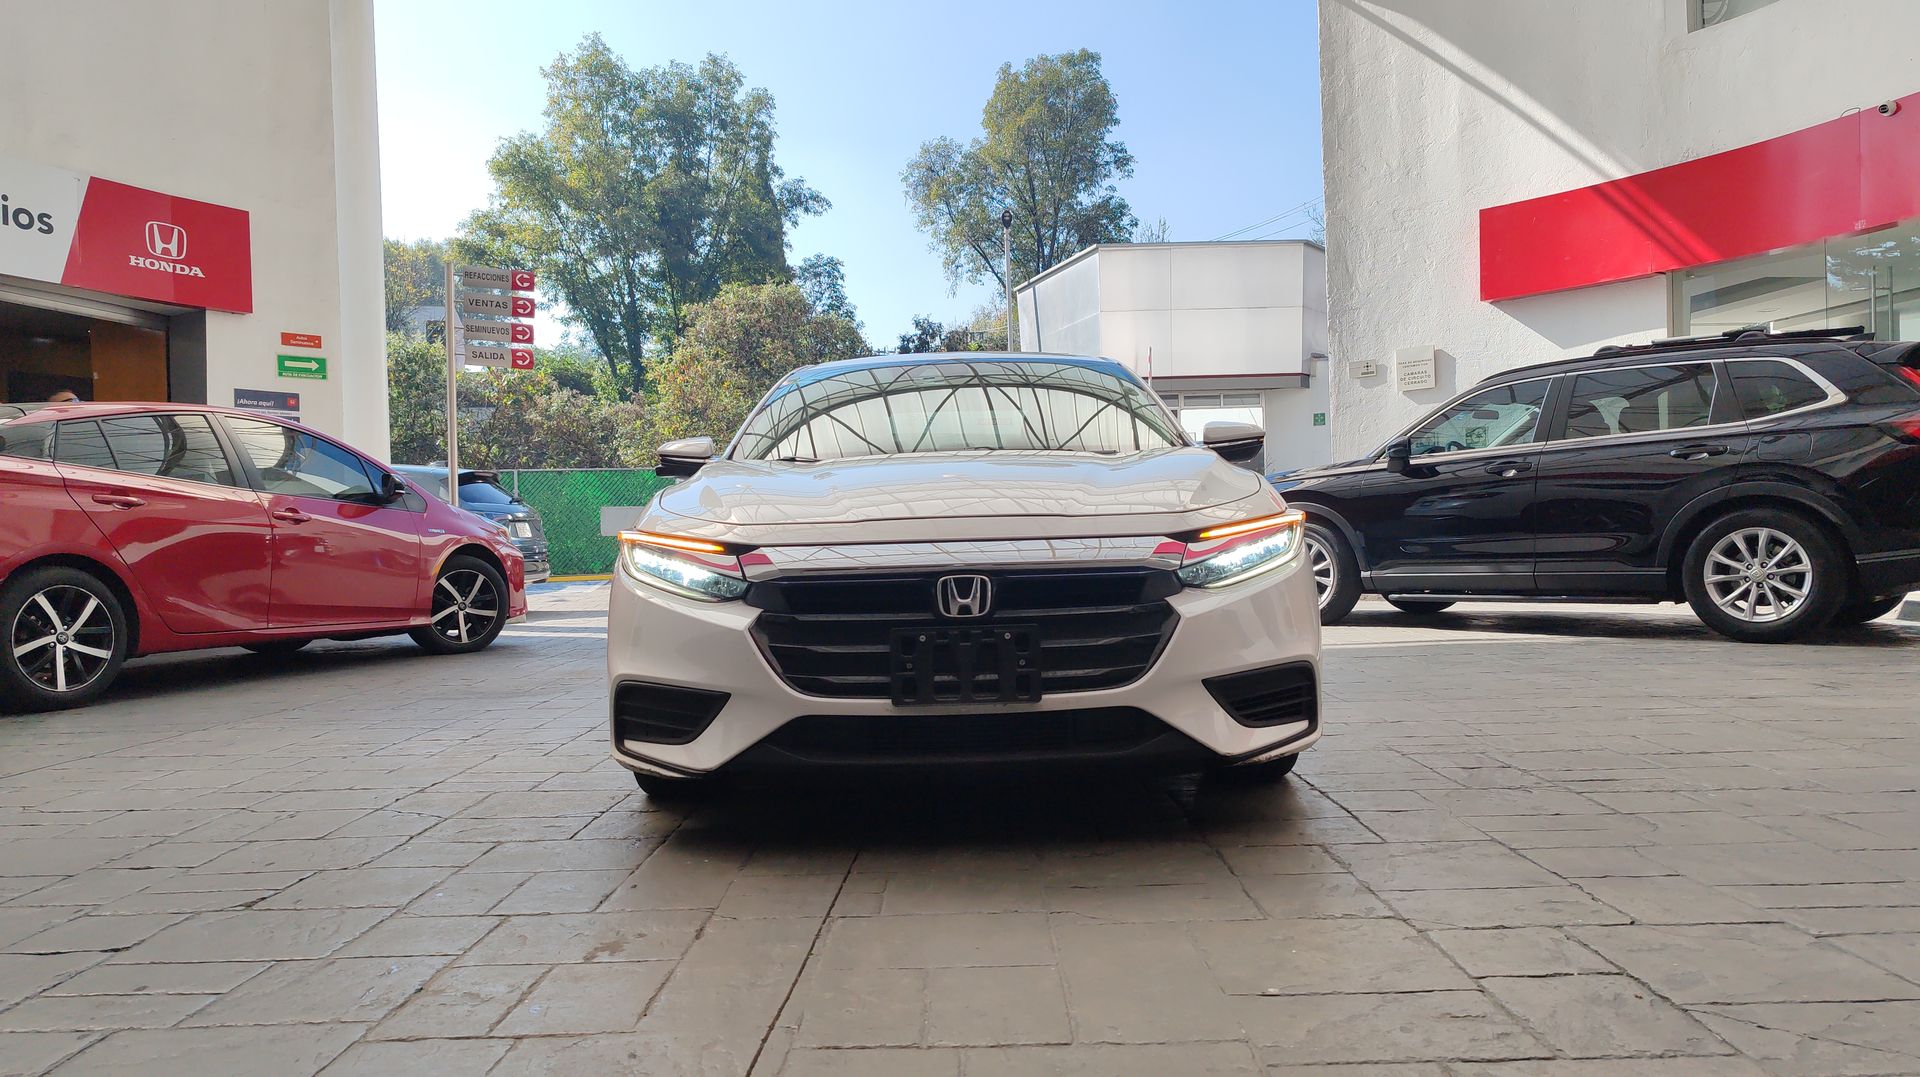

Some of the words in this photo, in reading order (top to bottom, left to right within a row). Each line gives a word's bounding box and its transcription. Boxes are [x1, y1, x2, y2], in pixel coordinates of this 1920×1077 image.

[129, 255, 205, 278] HONDA
[464, 271, 510, 283] REFACCIONES
[468, 298, 508, 309] VENTAS
[465, 325, 510, 336] SEMINUEVOS
[471, 350, 505, 361] SALIDA
